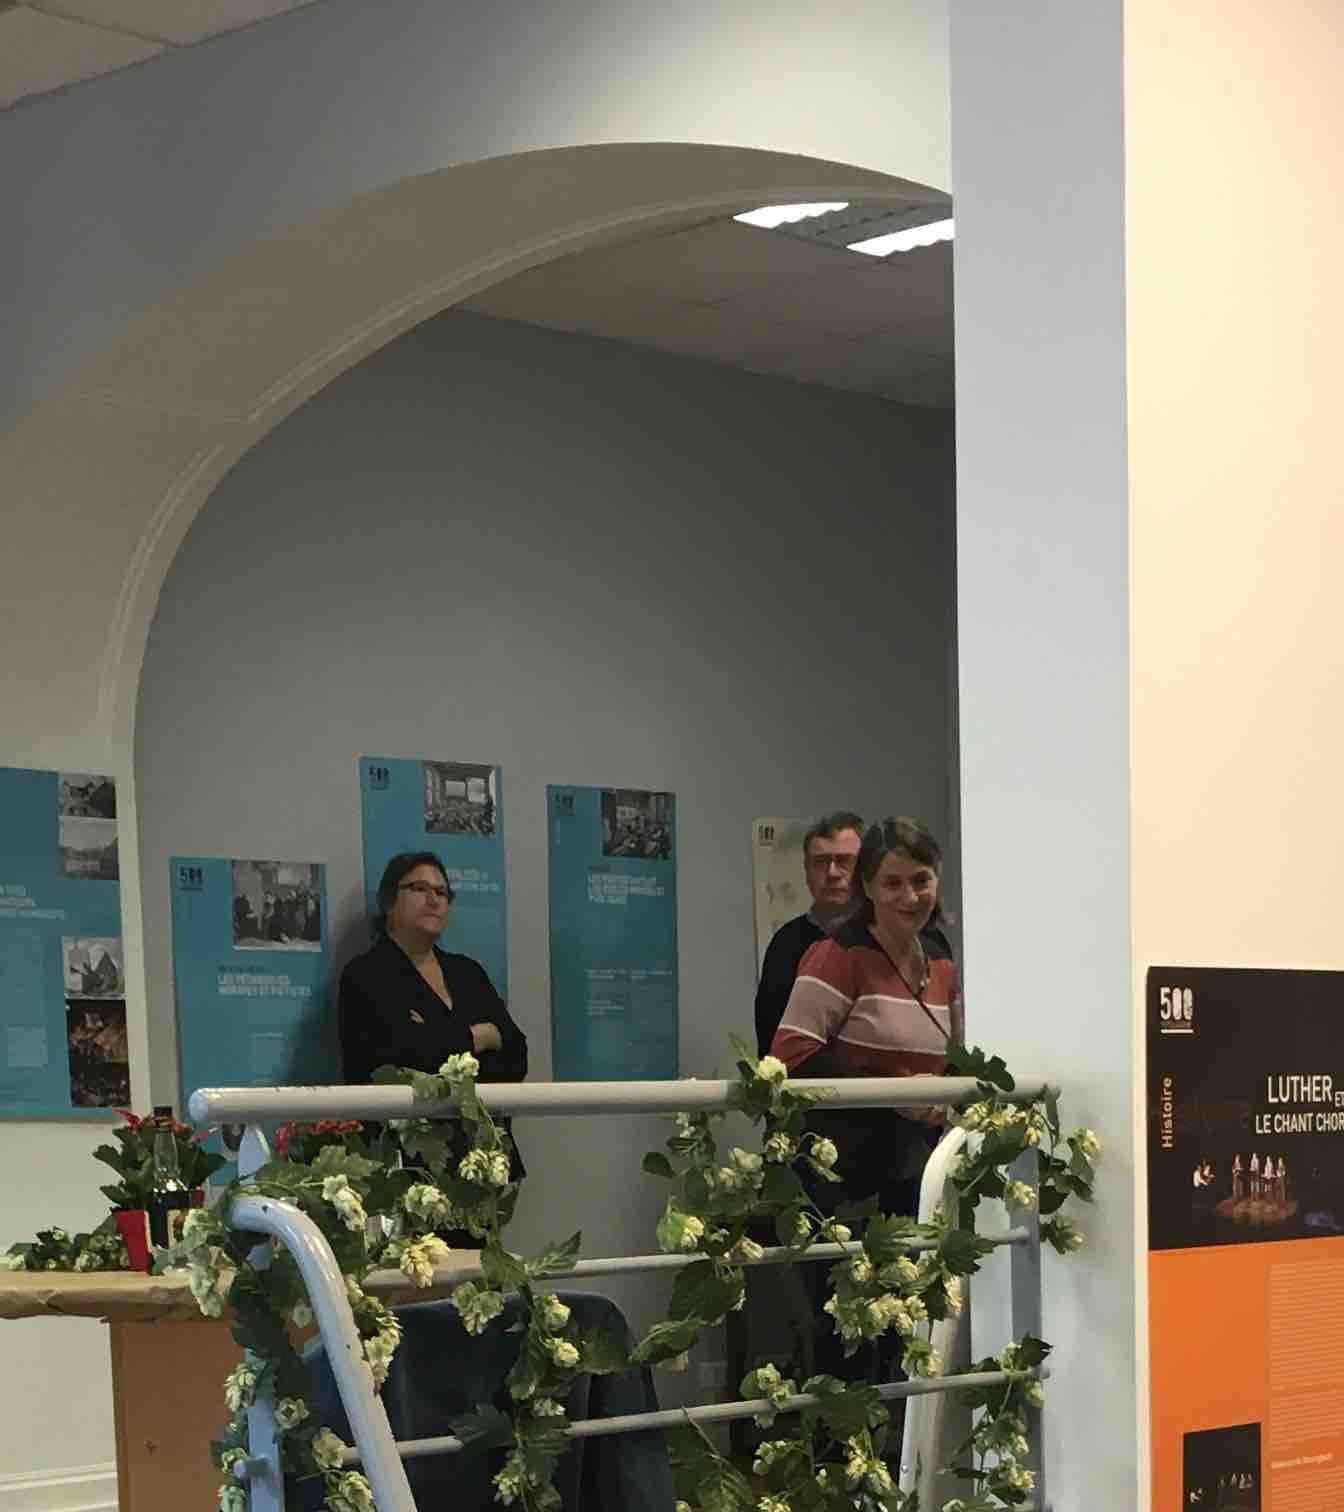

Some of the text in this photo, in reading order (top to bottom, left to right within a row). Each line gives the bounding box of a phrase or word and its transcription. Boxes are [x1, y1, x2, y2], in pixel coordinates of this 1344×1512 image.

[1267, 1075, 1333, 1103] LUTHER
[1161, 1077, 1174, 1148] Histoire
[1255, 1114, 1271, 1134] LE
[1274, 1112, 1315, 1133] CHANT
